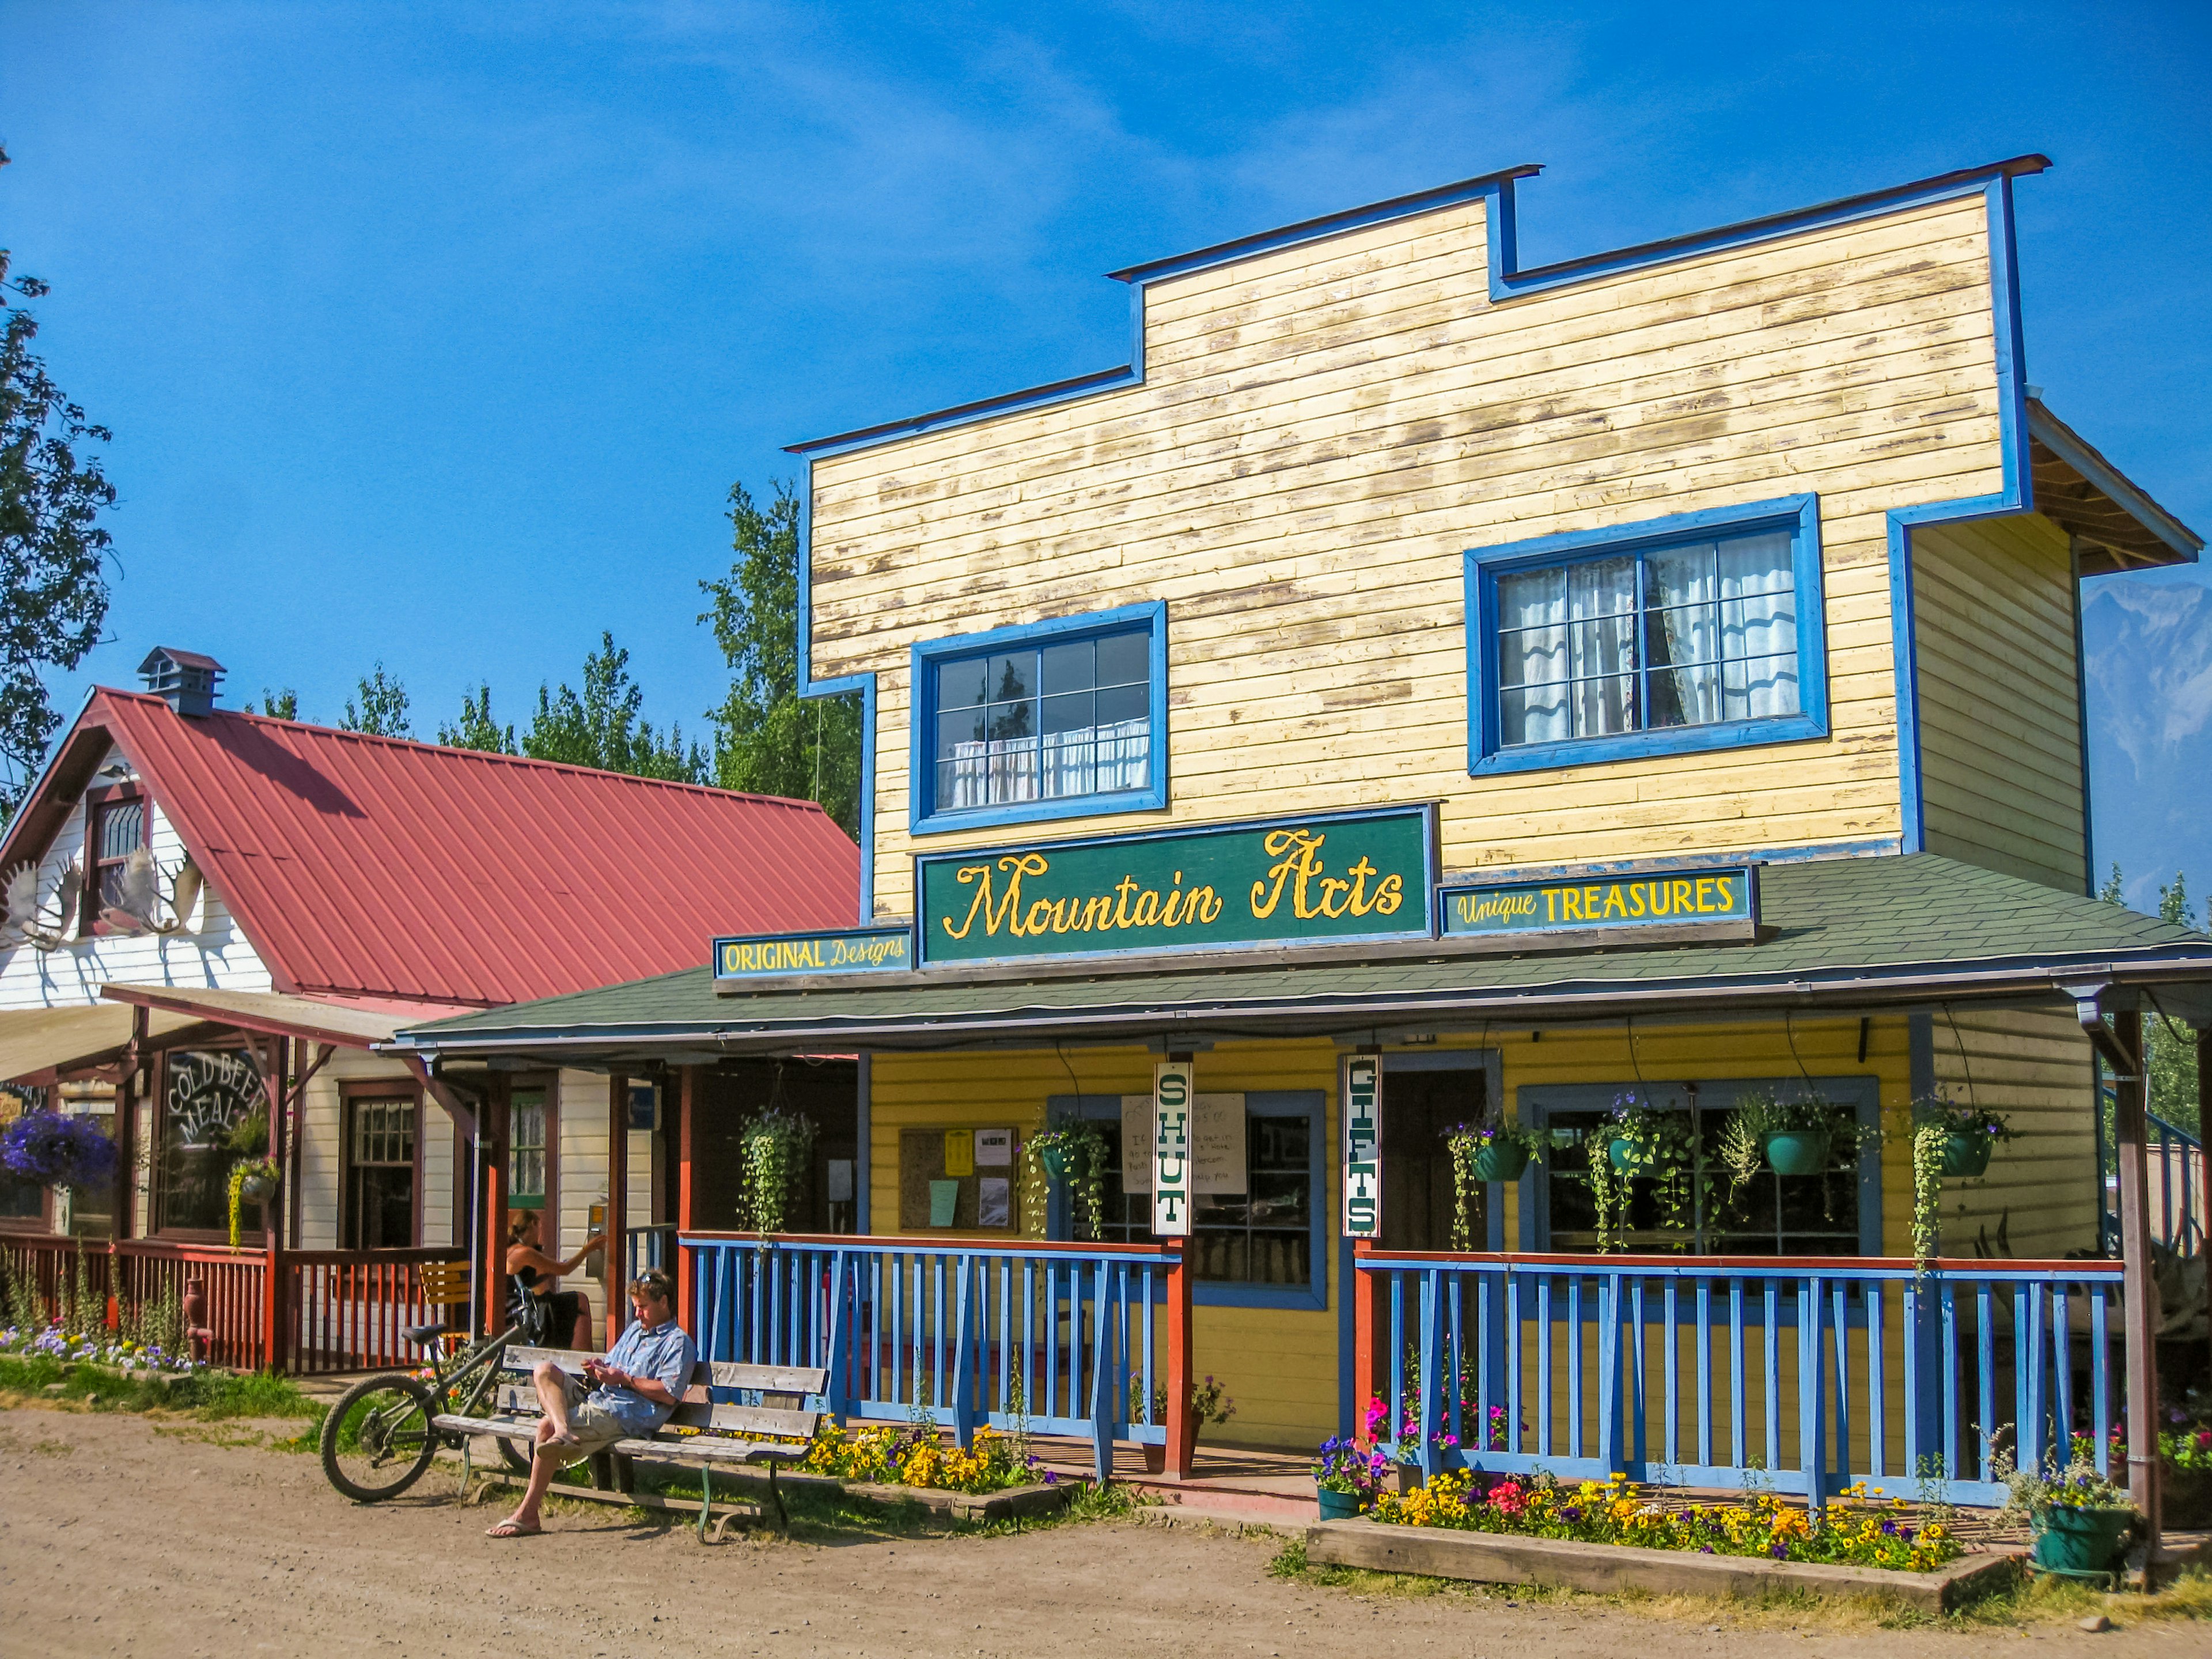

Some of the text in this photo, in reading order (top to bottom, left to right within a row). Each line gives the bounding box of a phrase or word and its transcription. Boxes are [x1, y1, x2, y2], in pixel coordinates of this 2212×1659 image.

[942, 828, 1403, 940] Mountain Arts
[1458, 877, 1734, 924] Unique TREASURES
[725, 937, 904, 972] ORIGINAL Designs
[169, 1053, 266, 1115] COLD BEER
[1157, 1074, 1187, 1222] SHUT
[1349, 1059, 1377, 1232] GIFTS
